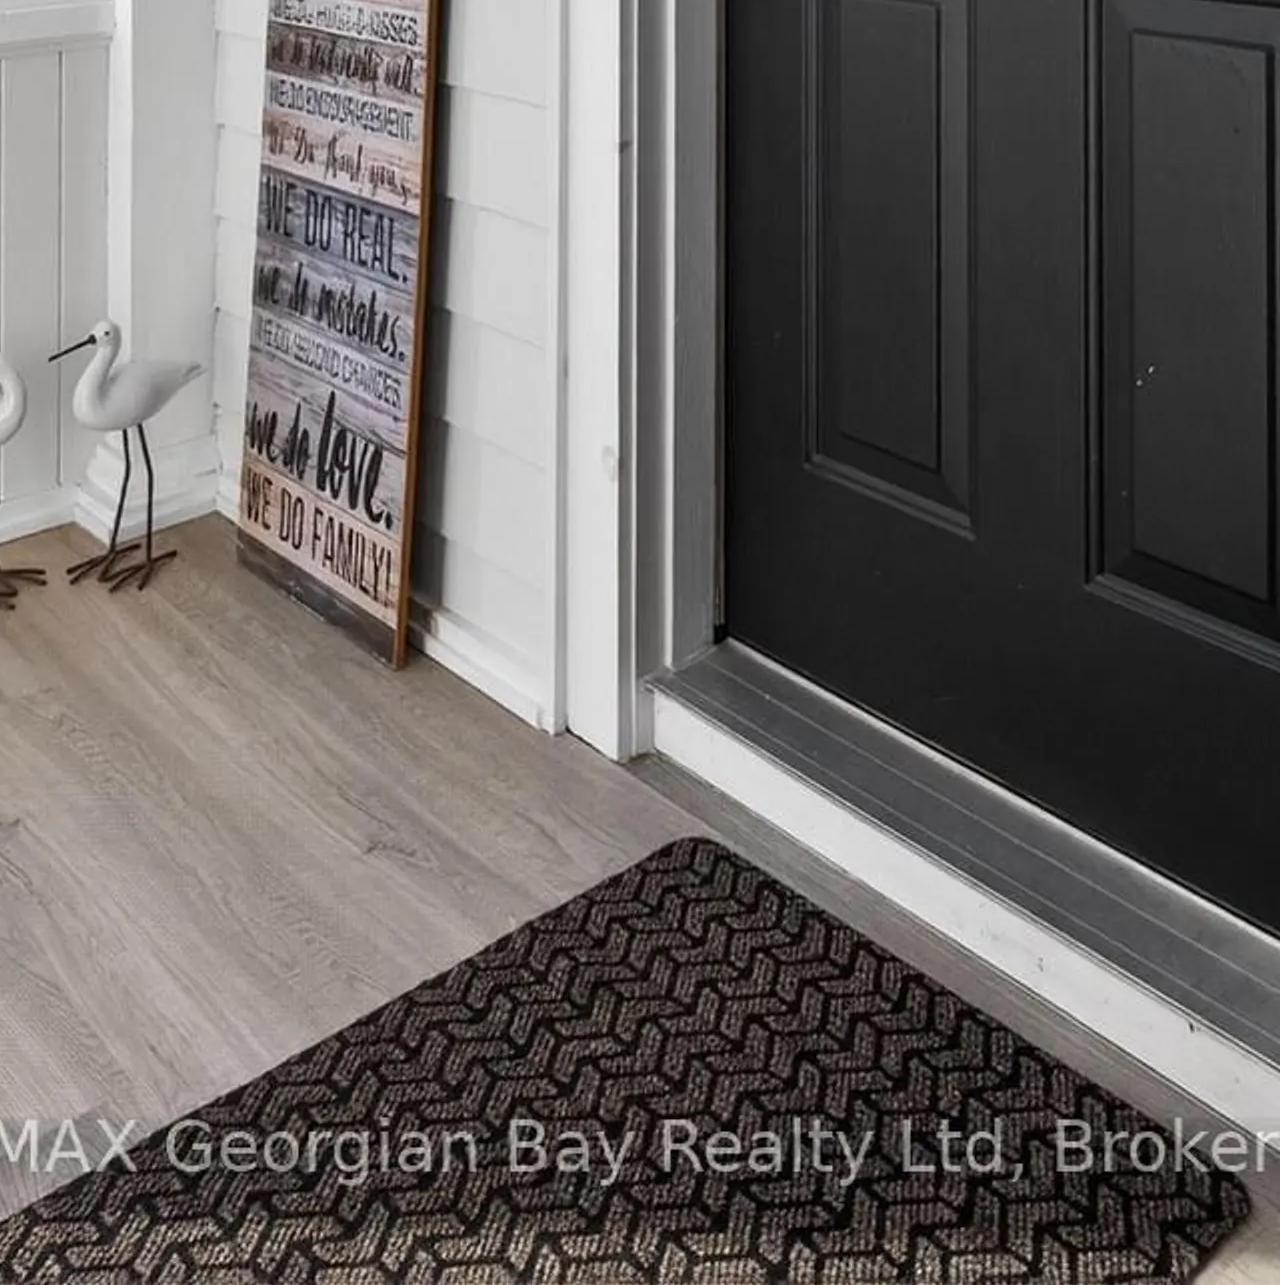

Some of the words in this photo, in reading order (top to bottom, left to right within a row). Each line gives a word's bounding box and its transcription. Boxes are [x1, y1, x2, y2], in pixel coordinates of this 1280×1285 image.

[264, 176, 295, 237] WE
[304, 189, 332, 252] DO
[247, 400, 277, 463] we
[282, 400, 310, 480] do
[246, 467, 272, 531] WE
[278, 487, 304, 550] DO
[311, 506, 394, 609] FAMILY!
